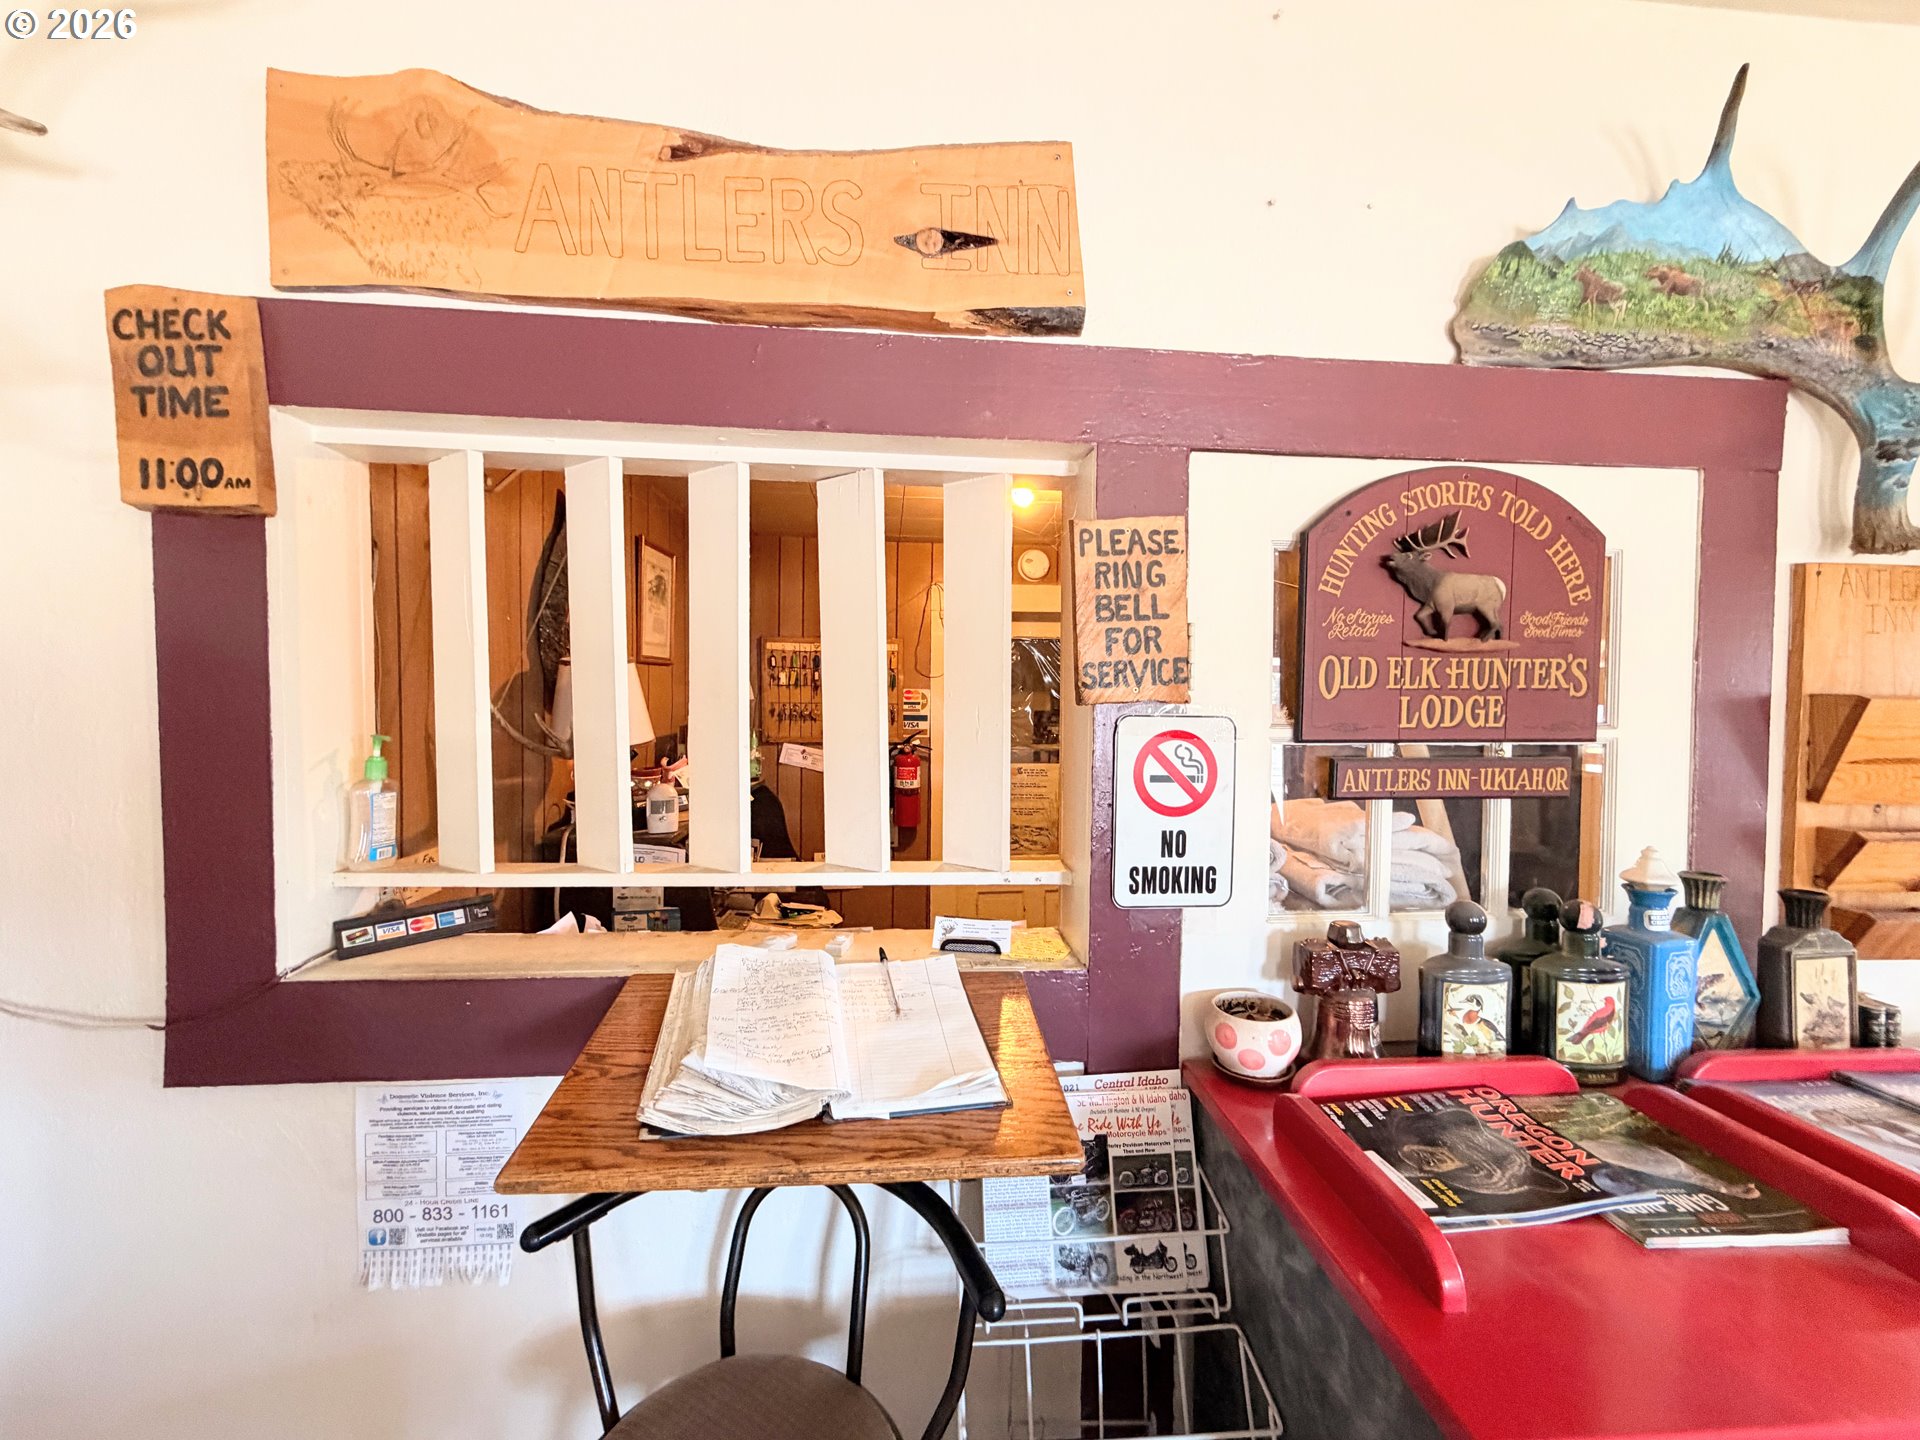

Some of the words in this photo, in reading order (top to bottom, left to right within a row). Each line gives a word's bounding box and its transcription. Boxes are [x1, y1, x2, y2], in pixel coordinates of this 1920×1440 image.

[514, 163, 865, 267] ANTLERS
[919, 183, 1071, 277] INN
[112, 308, 231, 340] CHECK
[137, 344, 223, 378] OUT
[130, 385, 230, 419] TIME
[140, 457, 224, 490] 11:00
[224, 477, 251, 489] AM
[1318, 503, 1397, 598] HUNTING
[1400, 480, 1494, 516] STORIES
[1498, 489, 1553, 541] TOLD
[1545, 534, 1592, 606] HERE
[1095, 560, 1166, 590] RING
[1095, 593, 1170, 622] BELL
[1322, 606, 1345, 627] No
[1865, 603, 1917, 635] INN
[1105, 625, 1162, 657] FOR
[1328, 621, 1379, 640] Retold
[1082, 656, 1189, 690] SERVICE
[1318, 655, 1378, 699] OLD
[1386, 656, 1441, 690] ELK
[1445, 653, 1588, 697] HUNTER'S
[1398, 694, 1506, 729] LODGE
[1341, 767, 1431, 793] ANTLERS
[1160, 829, 1187, 858] NO
[1128, 865, 1218, 895] SMOKING
[382, 925, 402, 935] VISA
[1063, 1084, 1080, 1092] 021
[1094, 1076, 1135, 1090] Central
[1136, 1075, 1169, 1087] Idaho
[1146, 1093, 1167, 1103] Idaho
[1168, 1090, 1187, 1101] daho
[1087, 1116, 1113, 1134] Ride
[1115, 1114, 1143, 1131] With
[1106, 1129, 1146, 1139] Motorcycle
[1448, 1089, 1586, 1181] HUNTER
[1474, 1086, 1602, 1167] OREGON
[373, 1207, 405, 1224] 800
[421, 1206, 454, 1221] 833
[471, 1203, 509, 1220] 1161
